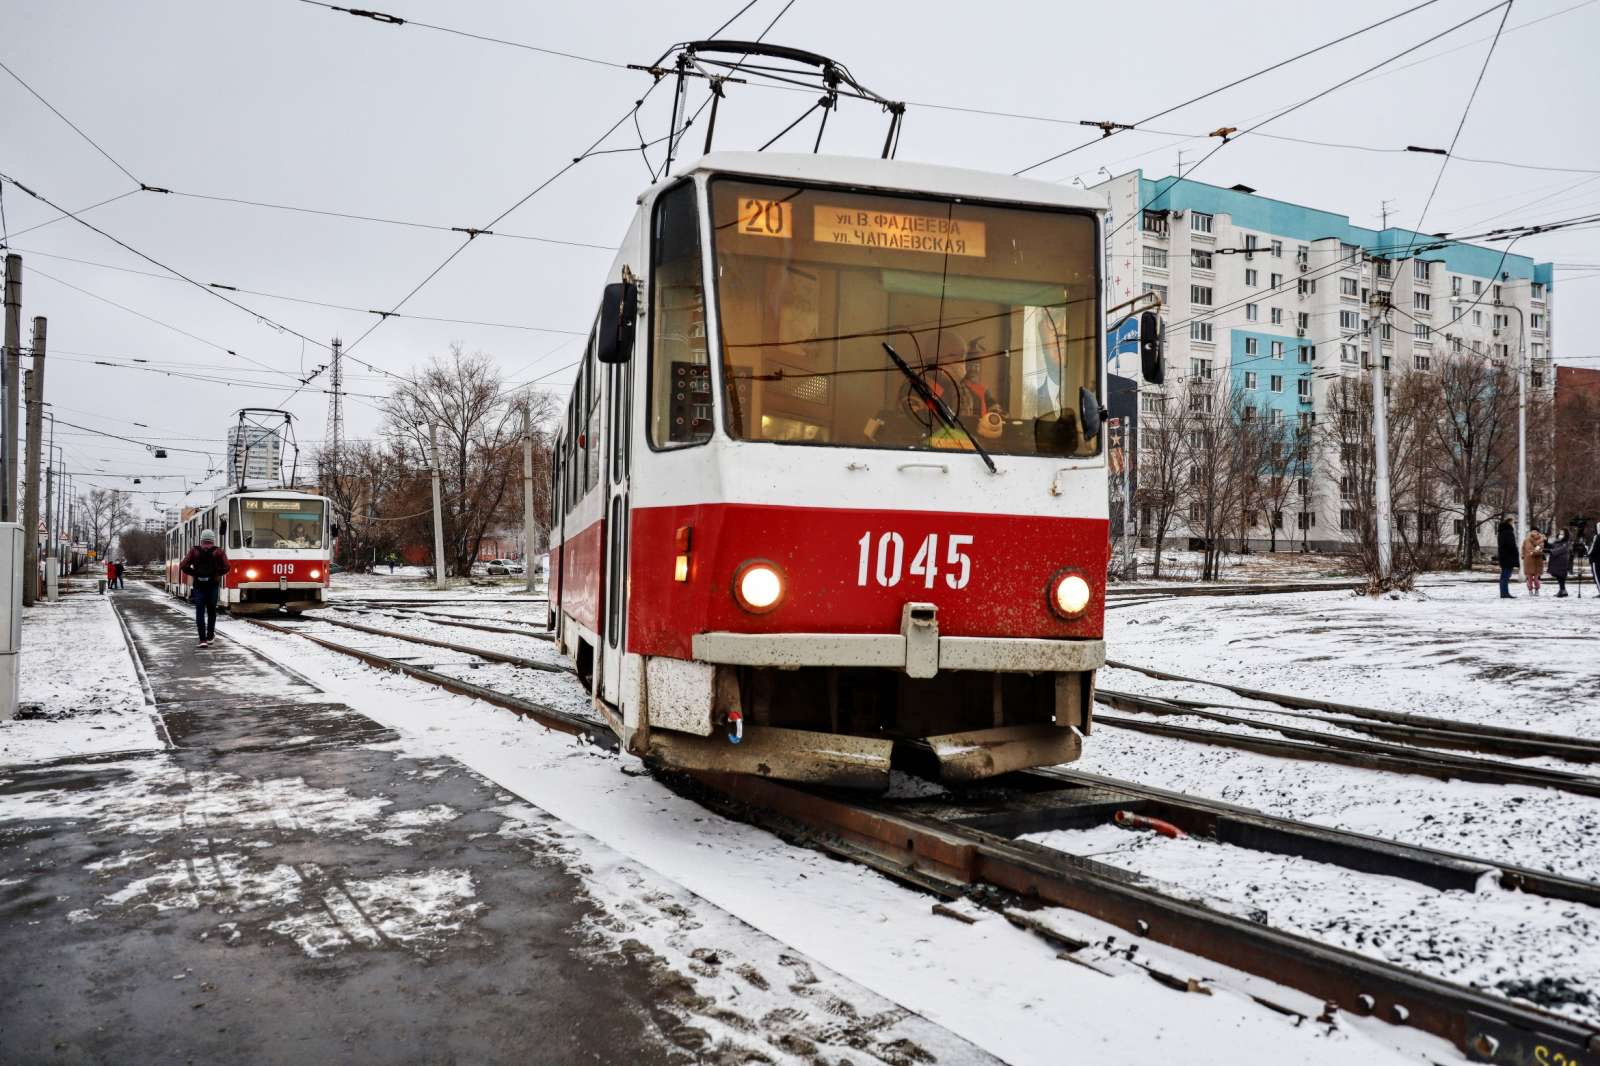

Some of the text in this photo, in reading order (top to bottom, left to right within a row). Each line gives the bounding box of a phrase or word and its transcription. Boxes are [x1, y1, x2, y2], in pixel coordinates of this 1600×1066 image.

[745, 199, 783, 234] 20
[874, 214, 960, 235] ФАДЕЕВА
[854, 230, 966, 254] ЧАПАЕВСКАЯ
[272, 563, 295, 575] 1019
[857, 530, 975, 590] 1045
